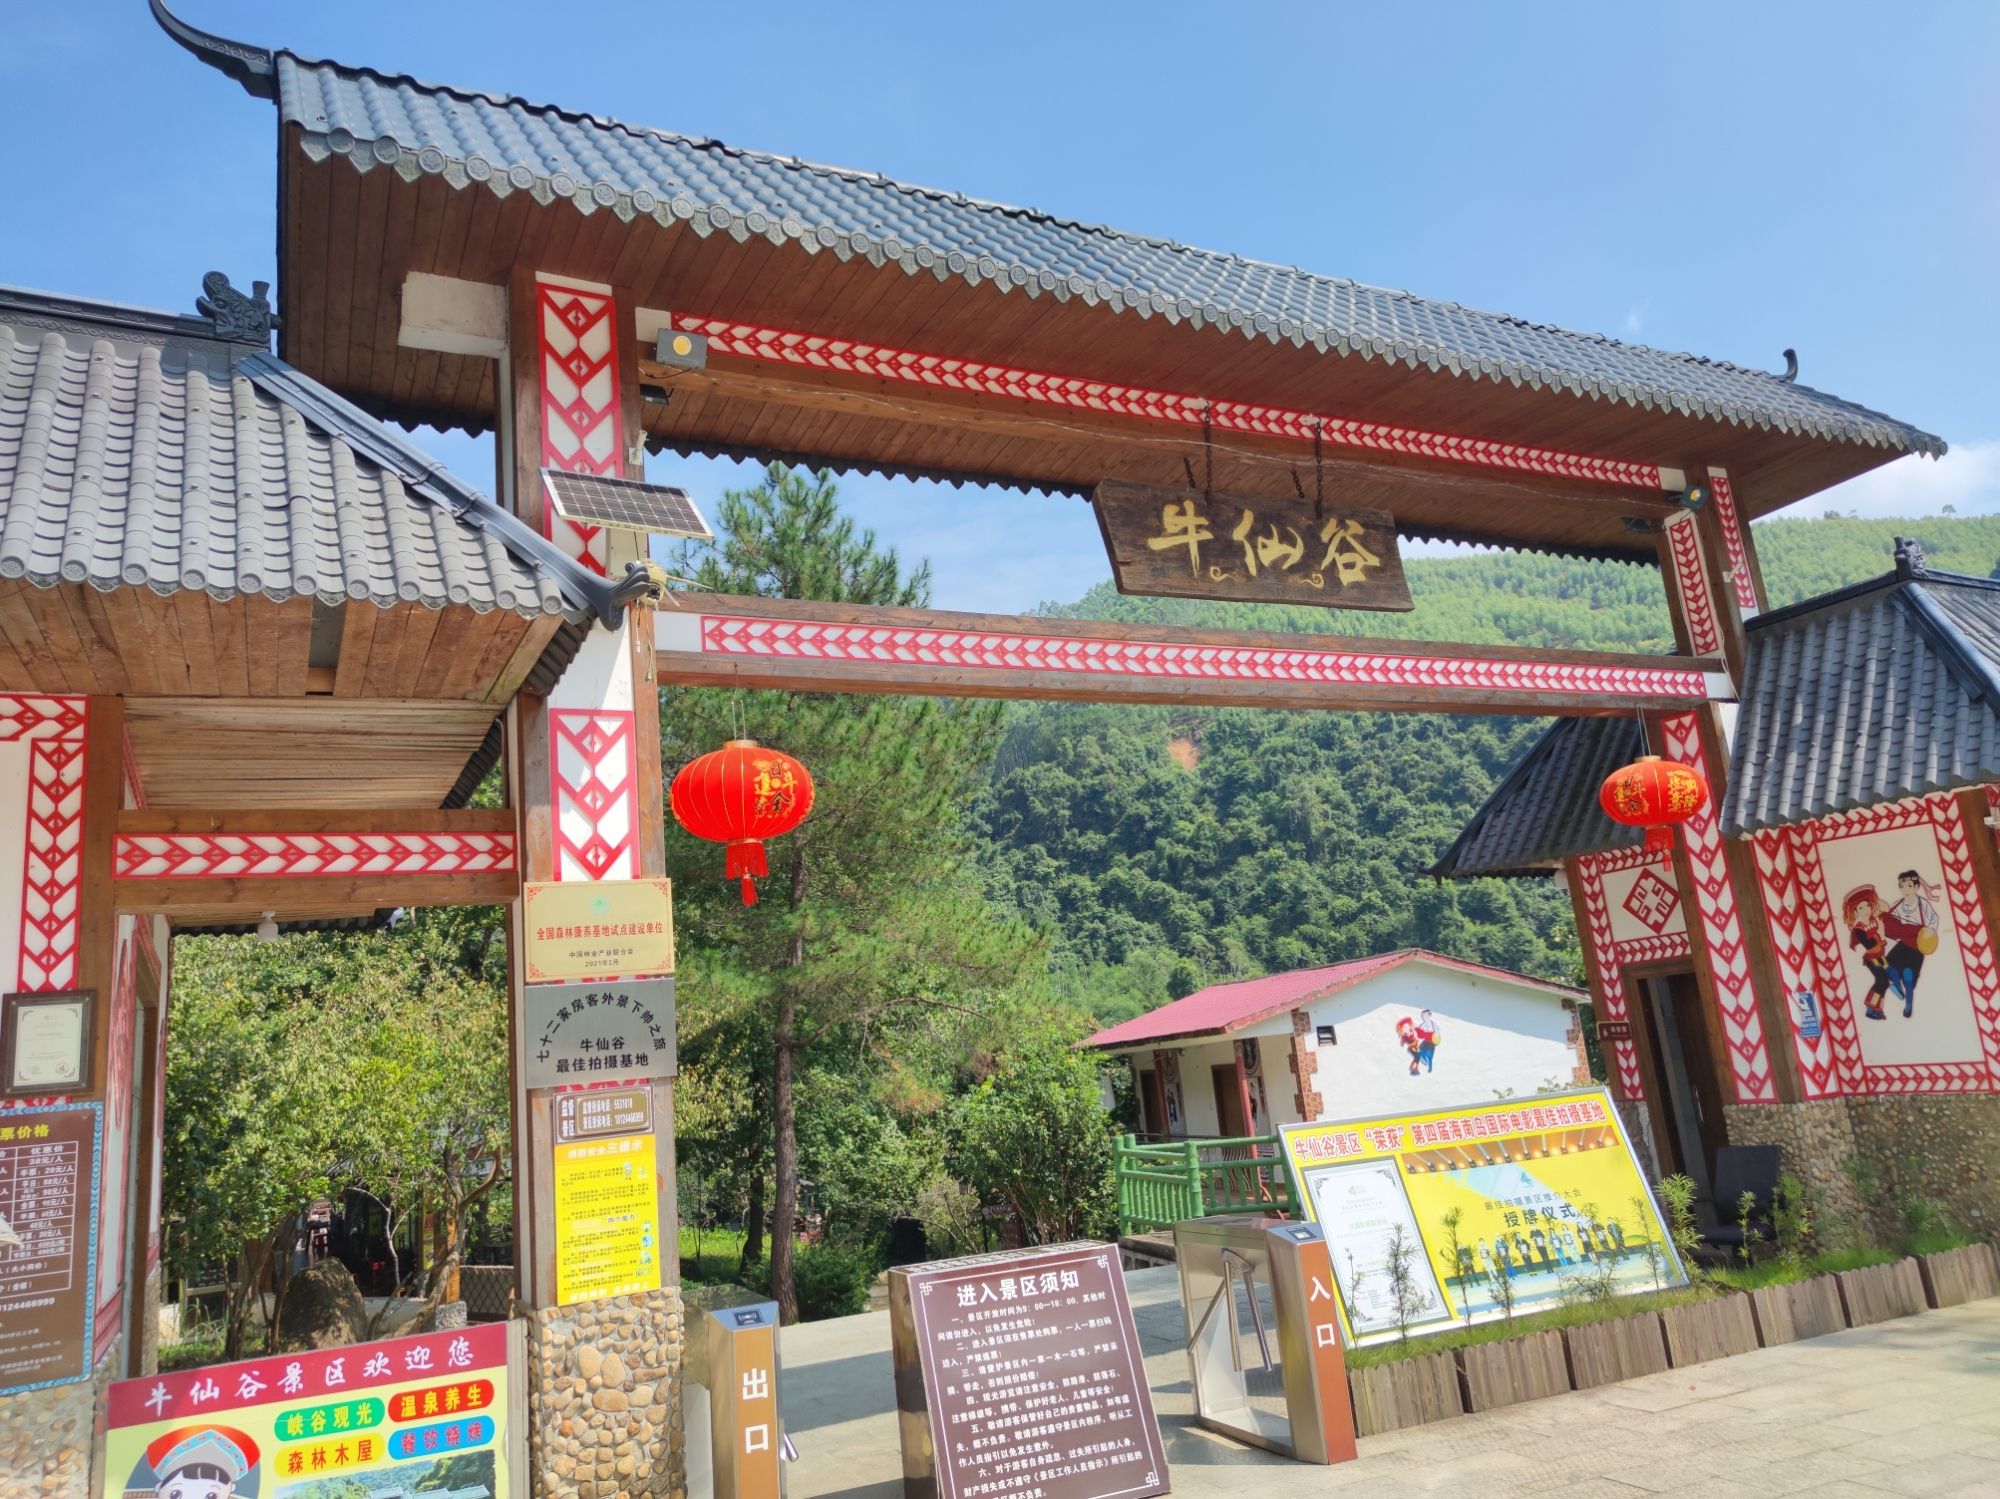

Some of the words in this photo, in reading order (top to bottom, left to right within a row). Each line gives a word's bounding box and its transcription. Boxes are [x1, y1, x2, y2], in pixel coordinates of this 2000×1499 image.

[1147, 500, 1380, 587] 牛仙谷
[536, 921, 663, 940] 全国森林康养基地试点建设单位
[580, 1036, 625, 1052] 牛仙谷
[556, 1053, 649, 1073] 最佳拍摄基地
[1504, 1203, 1576, 1228] 授牌仪式
[957, 1270, 1080, 1308] 进入景区须知
[1310, 1276, 1336, 1348] 入口
[145, 1337, 475, 1417] 牛仙谷景区欢迎您
[400, 1386, 483, 1417] 温泉养生
[742, 1368, 769, 1454] 出口
[287, 1403, 375, 1436] 峡谷观光
[401, 1422, 483, 1454] 餐饮烧烤
[288, 1439, 374, 1474] 森林木屋
